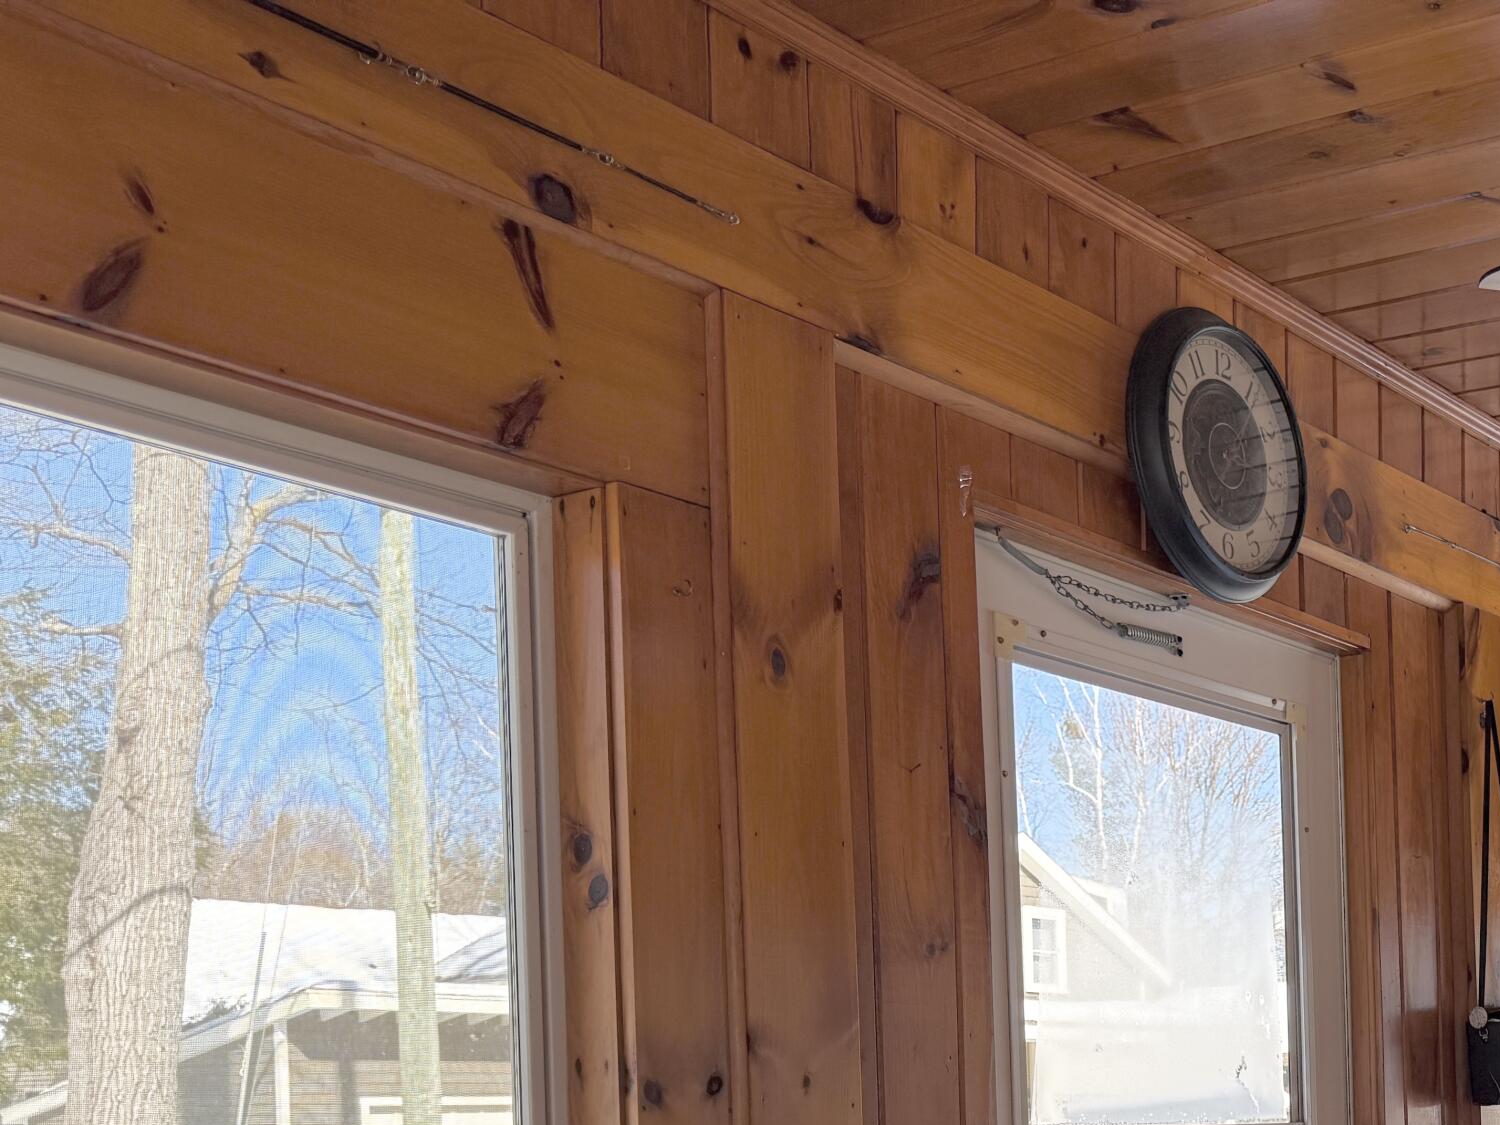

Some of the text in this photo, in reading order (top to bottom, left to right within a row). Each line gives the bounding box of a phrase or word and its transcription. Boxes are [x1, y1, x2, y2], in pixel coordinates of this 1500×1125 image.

[1188, 350, 1206, 379] 11
[1214, 348, 1232, 381] 12
[1170, 370, 1188, 405] 10
[1222, 532, 1235, 560] 6
[1246, 529, 1261, 559] 5
